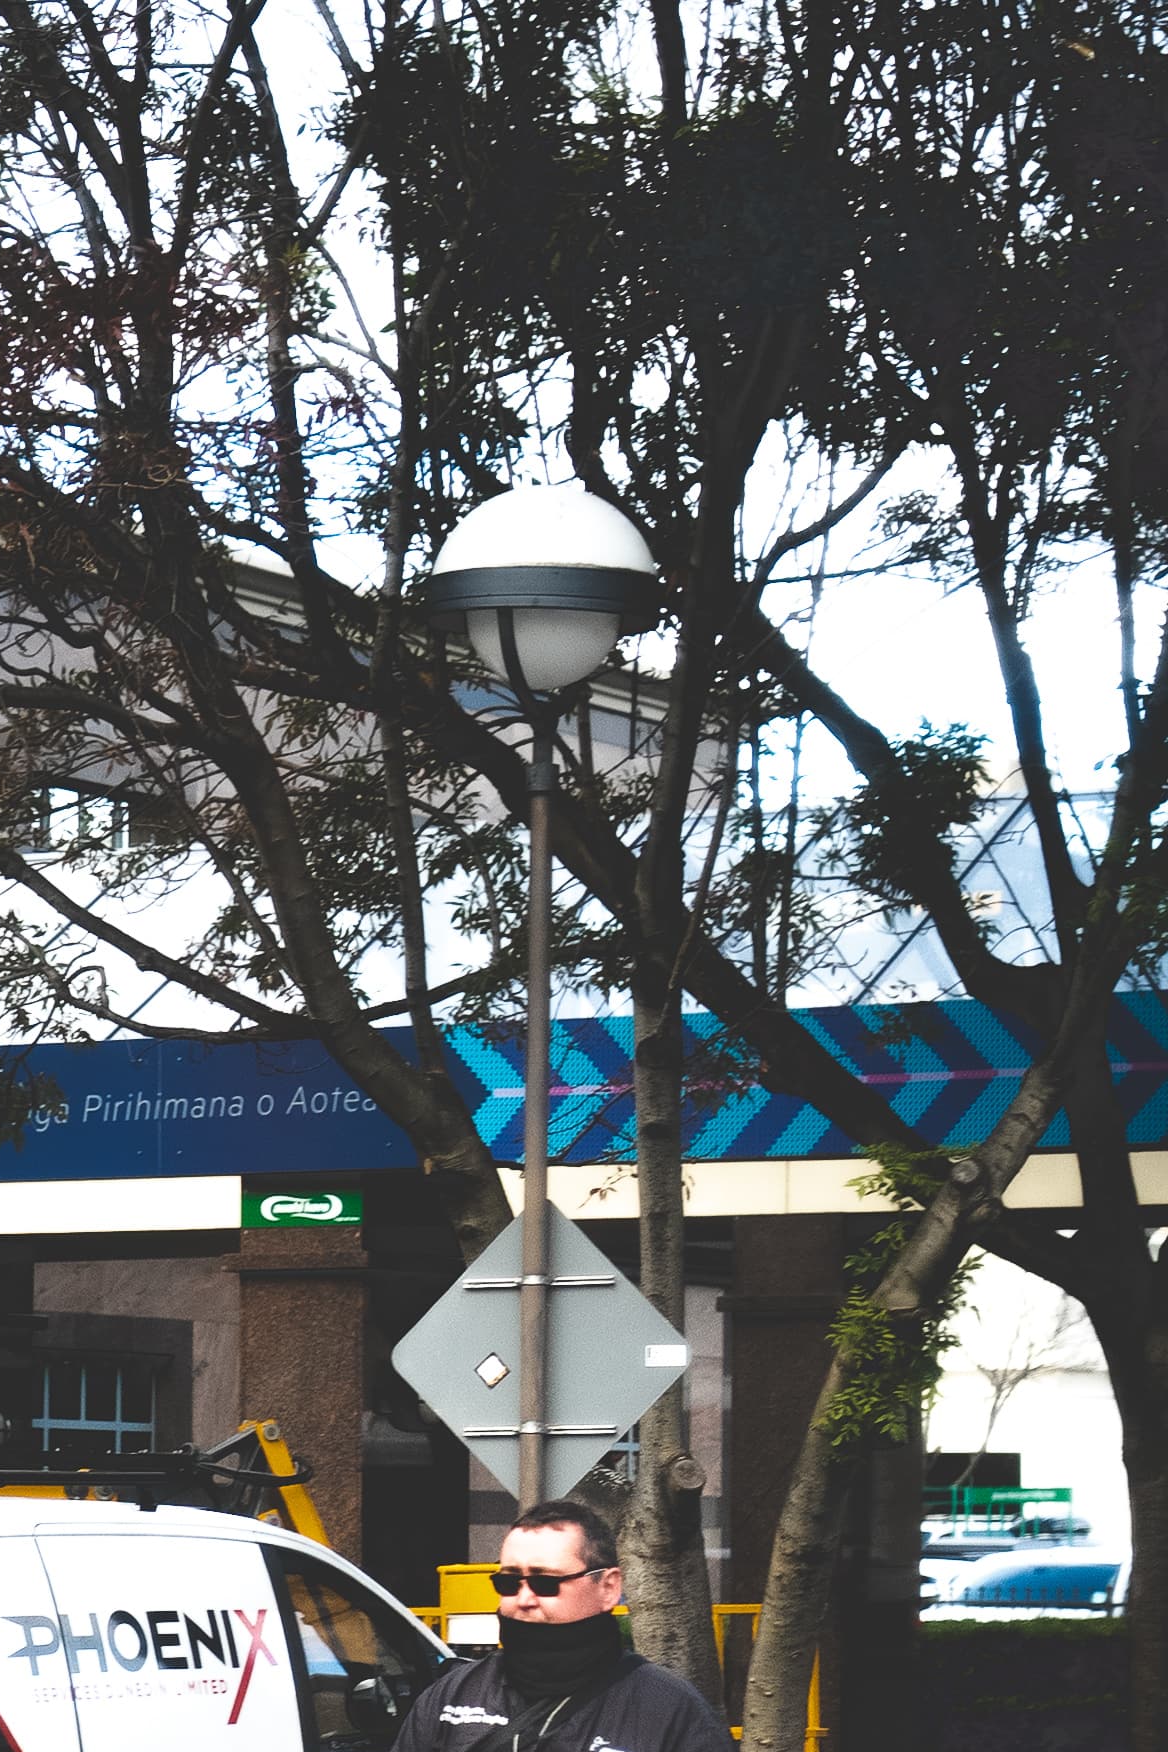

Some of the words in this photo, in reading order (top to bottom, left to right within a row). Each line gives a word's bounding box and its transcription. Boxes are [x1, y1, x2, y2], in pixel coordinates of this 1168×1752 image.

[83, 1091, 244, 1123] Pirihimana
[256, 1094, 274, 1116] o
[0, 1608, 279, 1725] PHOENIX
